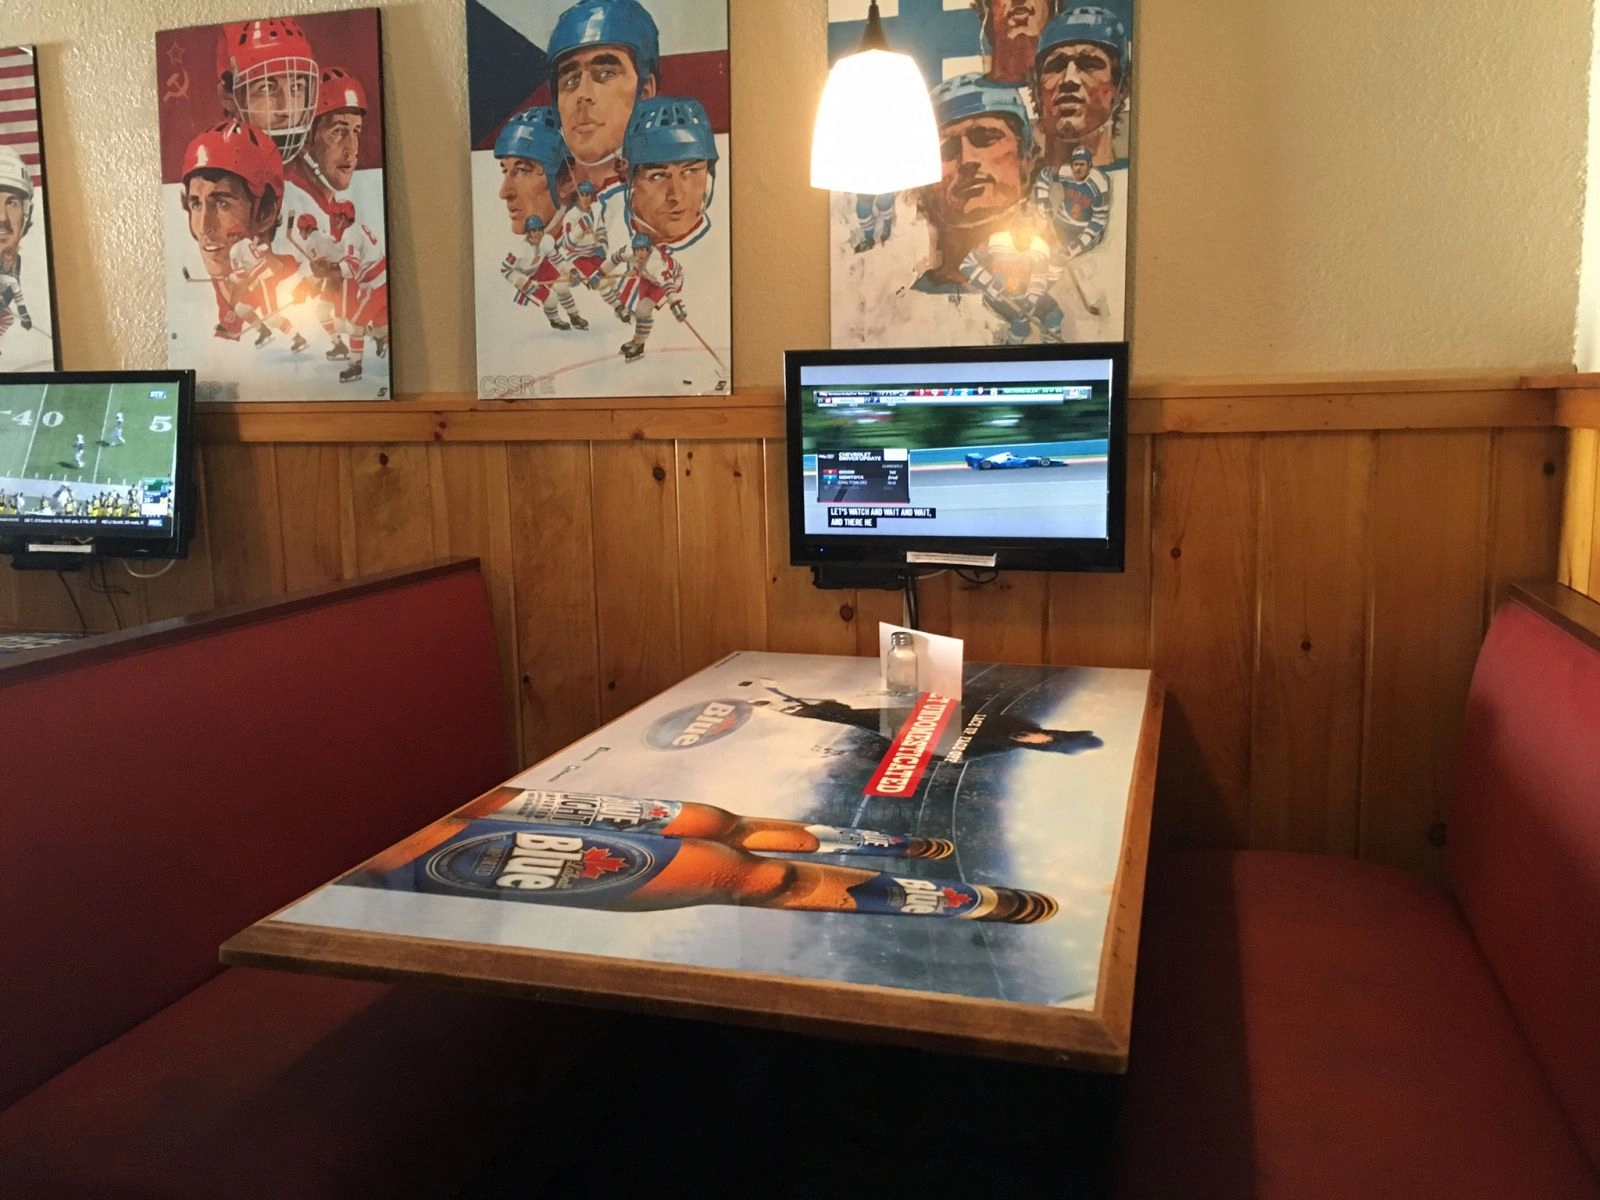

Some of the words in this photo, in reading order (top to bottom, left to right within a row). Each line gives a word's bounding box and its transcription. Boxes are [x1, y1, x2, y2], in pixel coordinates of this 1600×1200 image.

[830, 508, 848, 516] LET'S
[848, 508, 870, 516] WATCH
[870, 508, 883, 516] AND
[883, 508, 900, 516] WAIT
[900, 508, 914, 517] AND
[830, 518, 843, 526] AND
[844, 518, 863, 526] THERE
[864, 519, 873, 527] HE
[671, 702, 736, 747] Blue
[876, 703, 949, 793] UNDOMESTICATED
[496, 832, 584, 890] Blue
